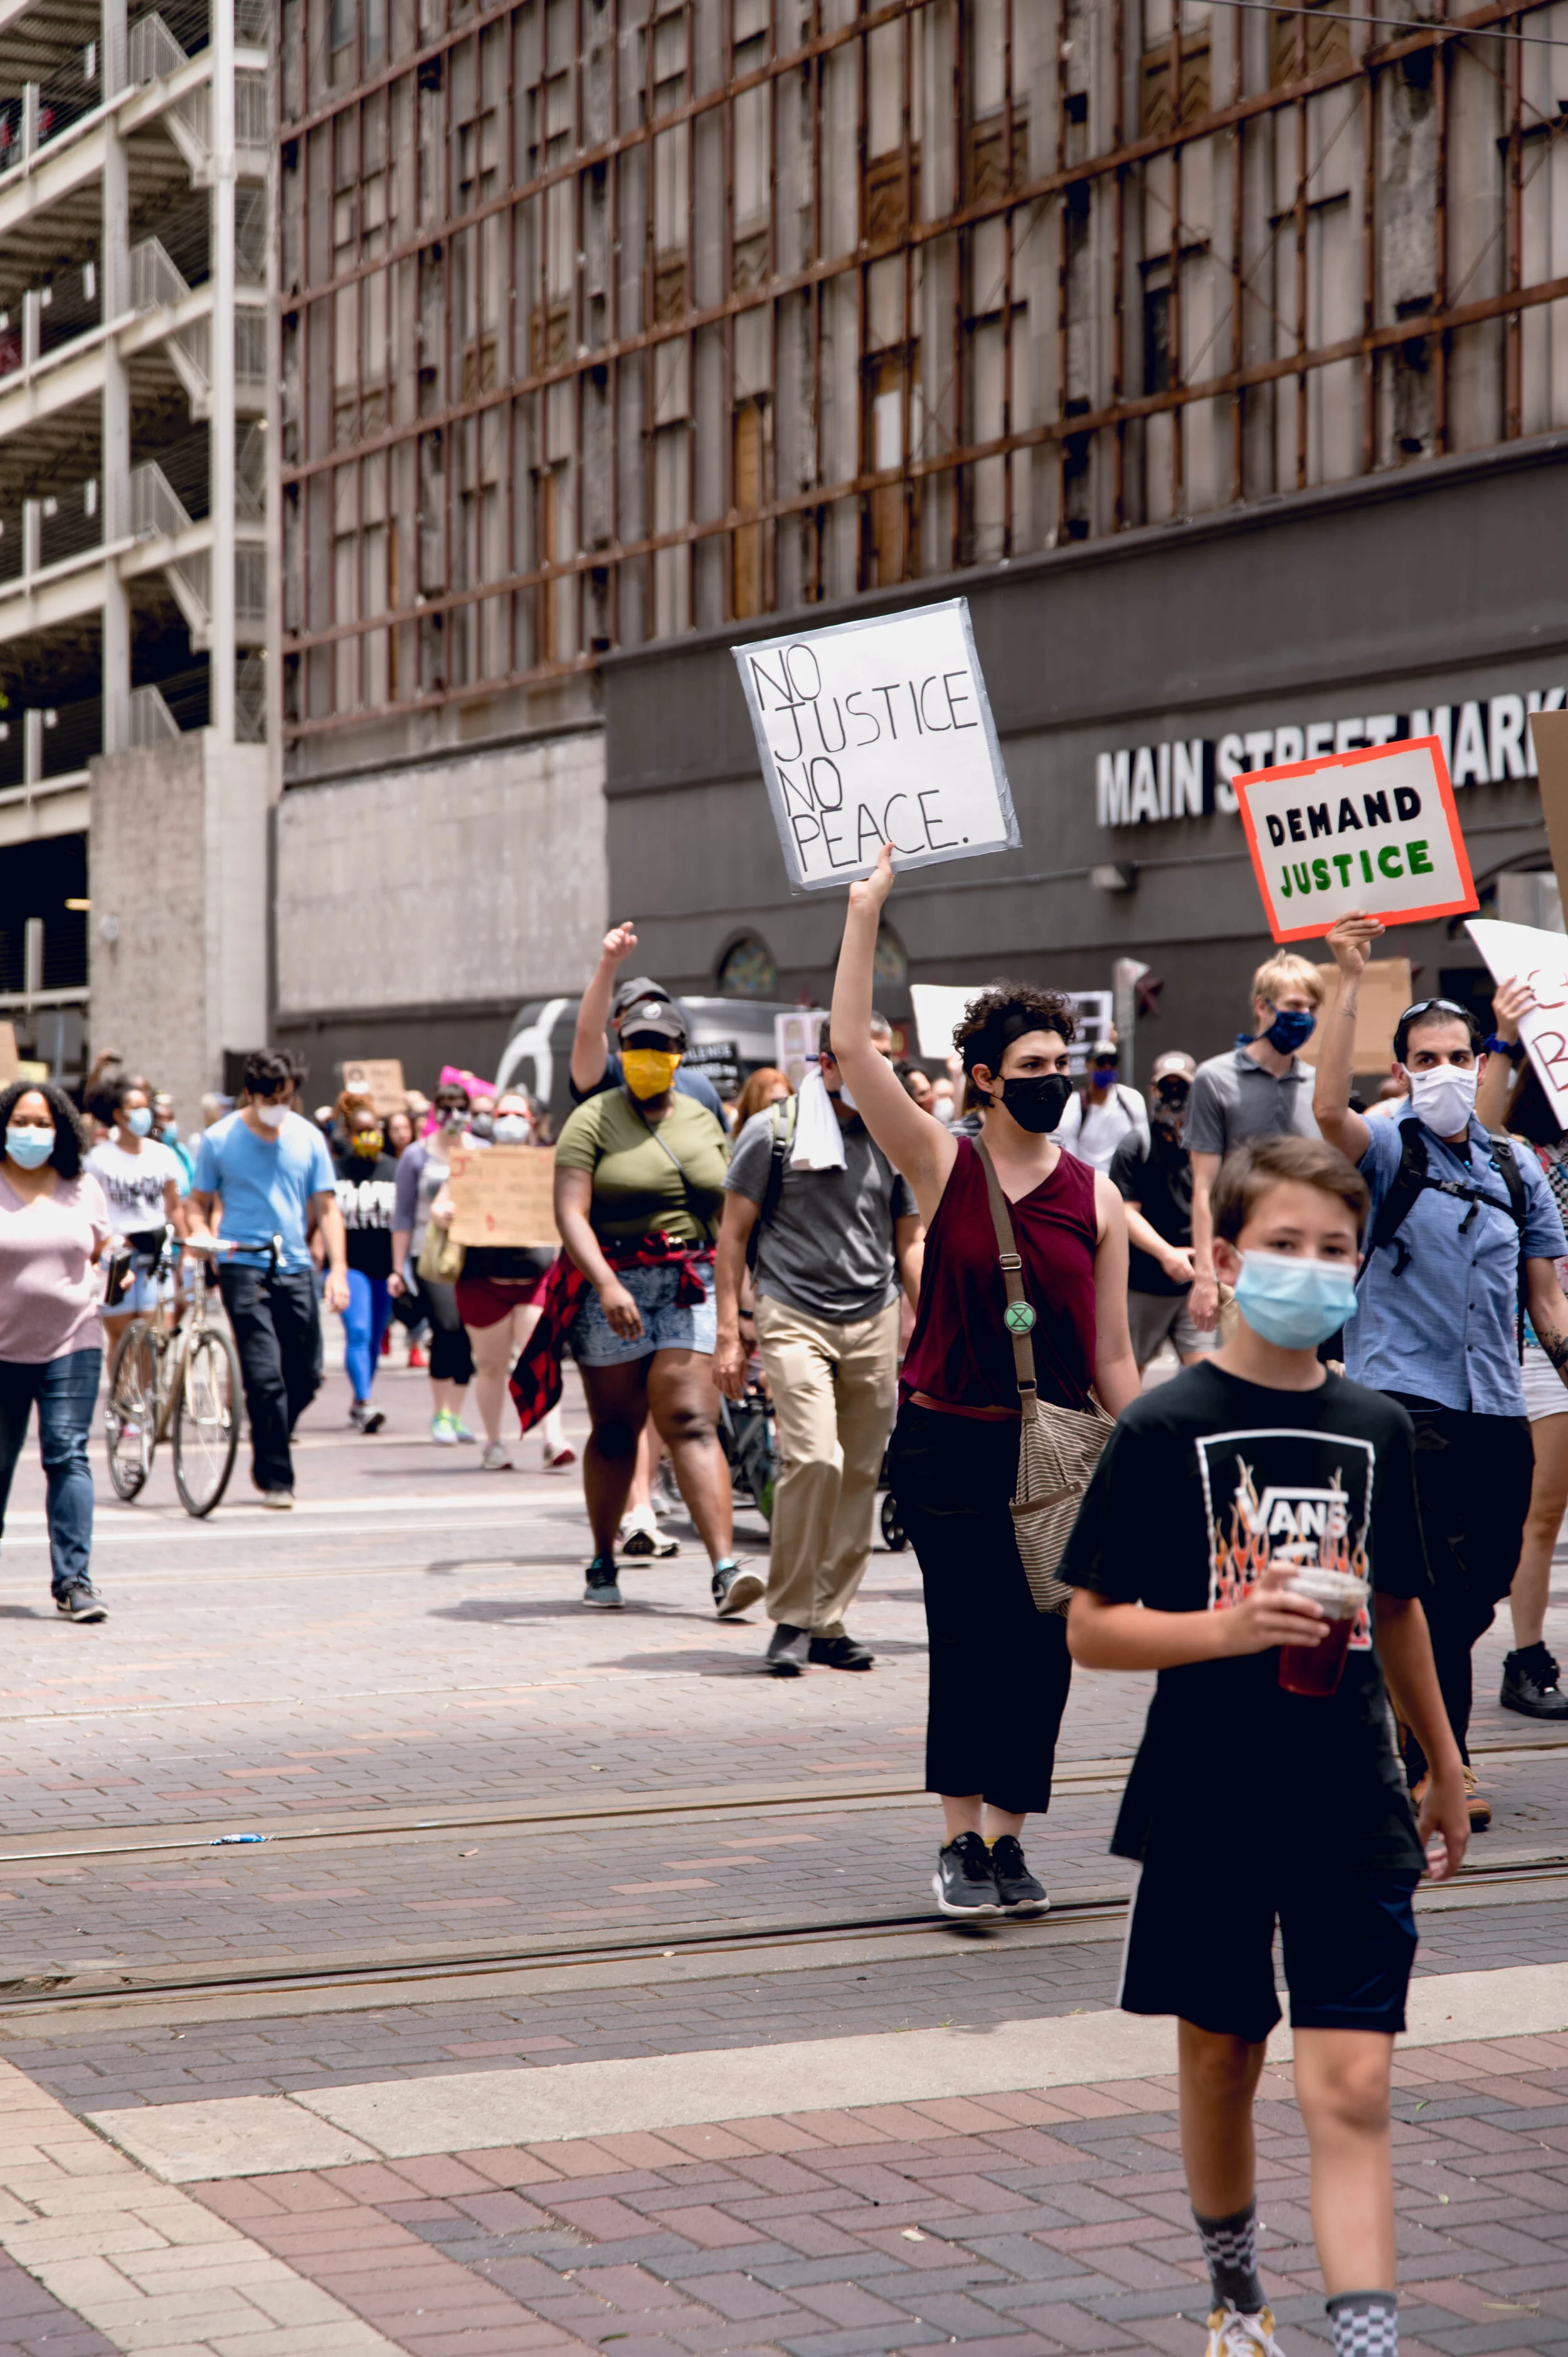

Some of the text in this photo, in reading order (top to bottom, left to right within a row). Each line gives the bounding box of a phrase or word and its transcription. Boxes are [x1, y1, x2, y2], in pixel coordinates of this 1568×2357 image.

[750, 643, 822, 711] NO
[774, 670, 978, 762] JUSTICE
[776, 755, 842, 817] NO
[1096, 738, 1205, 827] MAIN
[1409, 686, 1568, 789] MARK
[791, 789, 969, 872] PEACE.
[1265, 786, 1422, 847] DEMAND
[1280, 839, 1434, 898] JUSTICE
[1234, 1486, 1349, 1539] VANS
